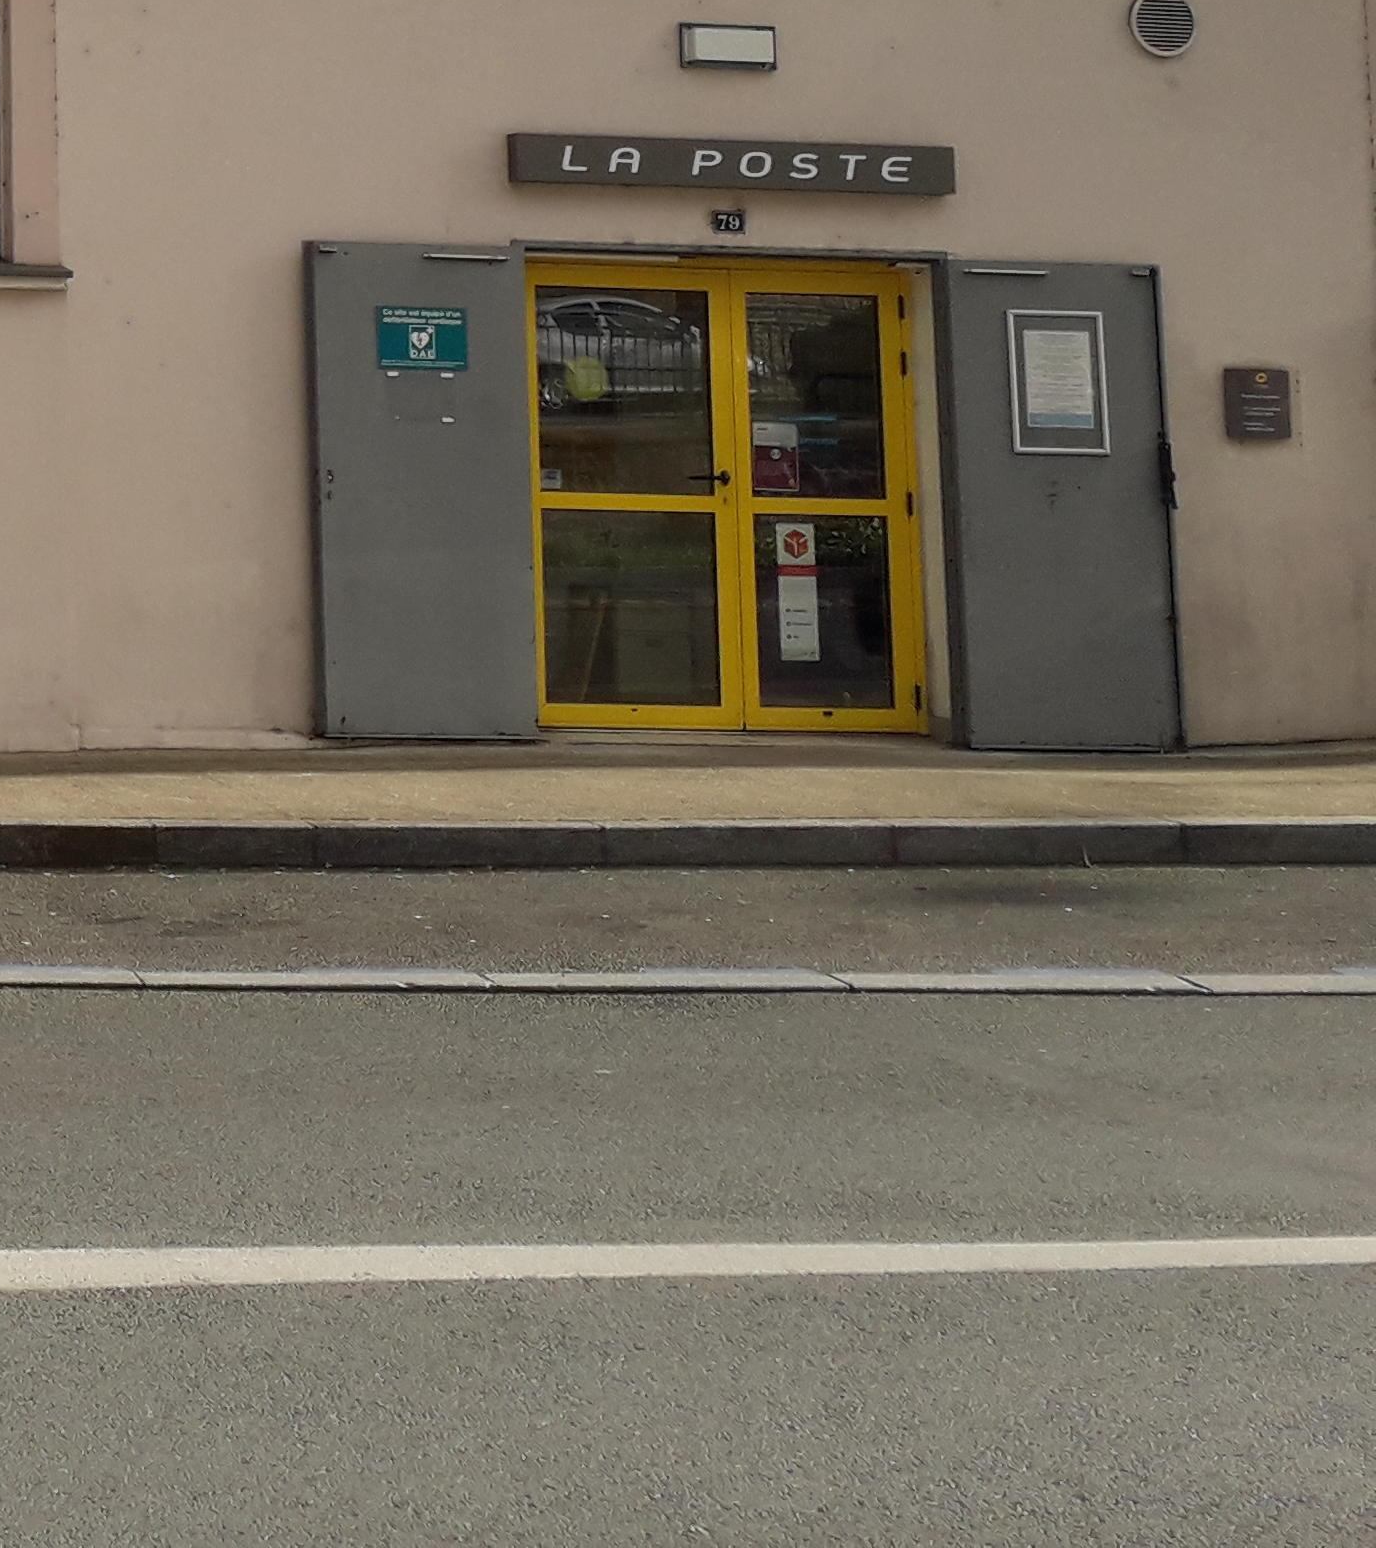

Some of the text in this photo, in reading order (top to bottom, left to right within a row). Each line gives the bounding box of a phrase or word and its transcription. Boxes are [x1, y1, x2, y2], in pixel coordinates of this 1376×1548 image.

[561, 144, 914, 182] LA POSTE
[718, 215, 740, 231] 79
